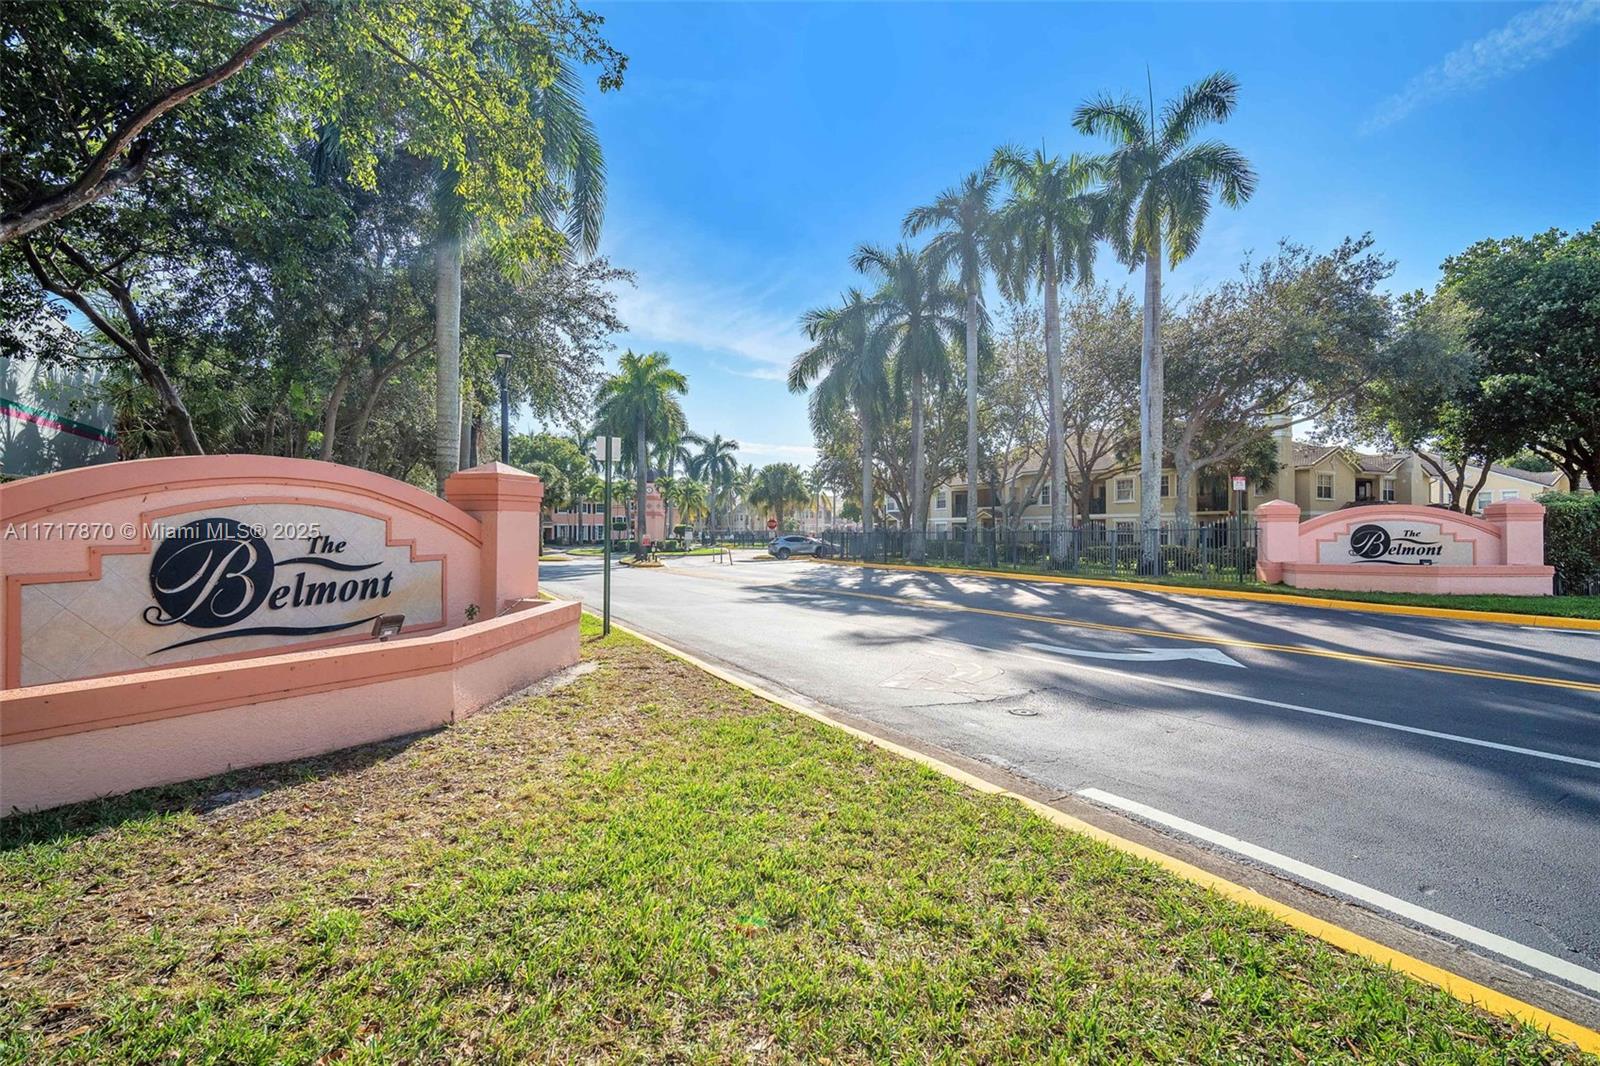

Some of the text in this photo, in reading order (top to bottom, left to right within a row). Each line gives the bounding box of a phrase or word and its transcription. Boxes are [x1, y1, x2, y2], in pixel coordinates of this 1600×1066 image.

[307, 535, 347, 555] The
[1348, 529, 1443, 557] Belmont
[1404, 529, 1421, 537] The
[143, 538, 394, 627] Belmont
